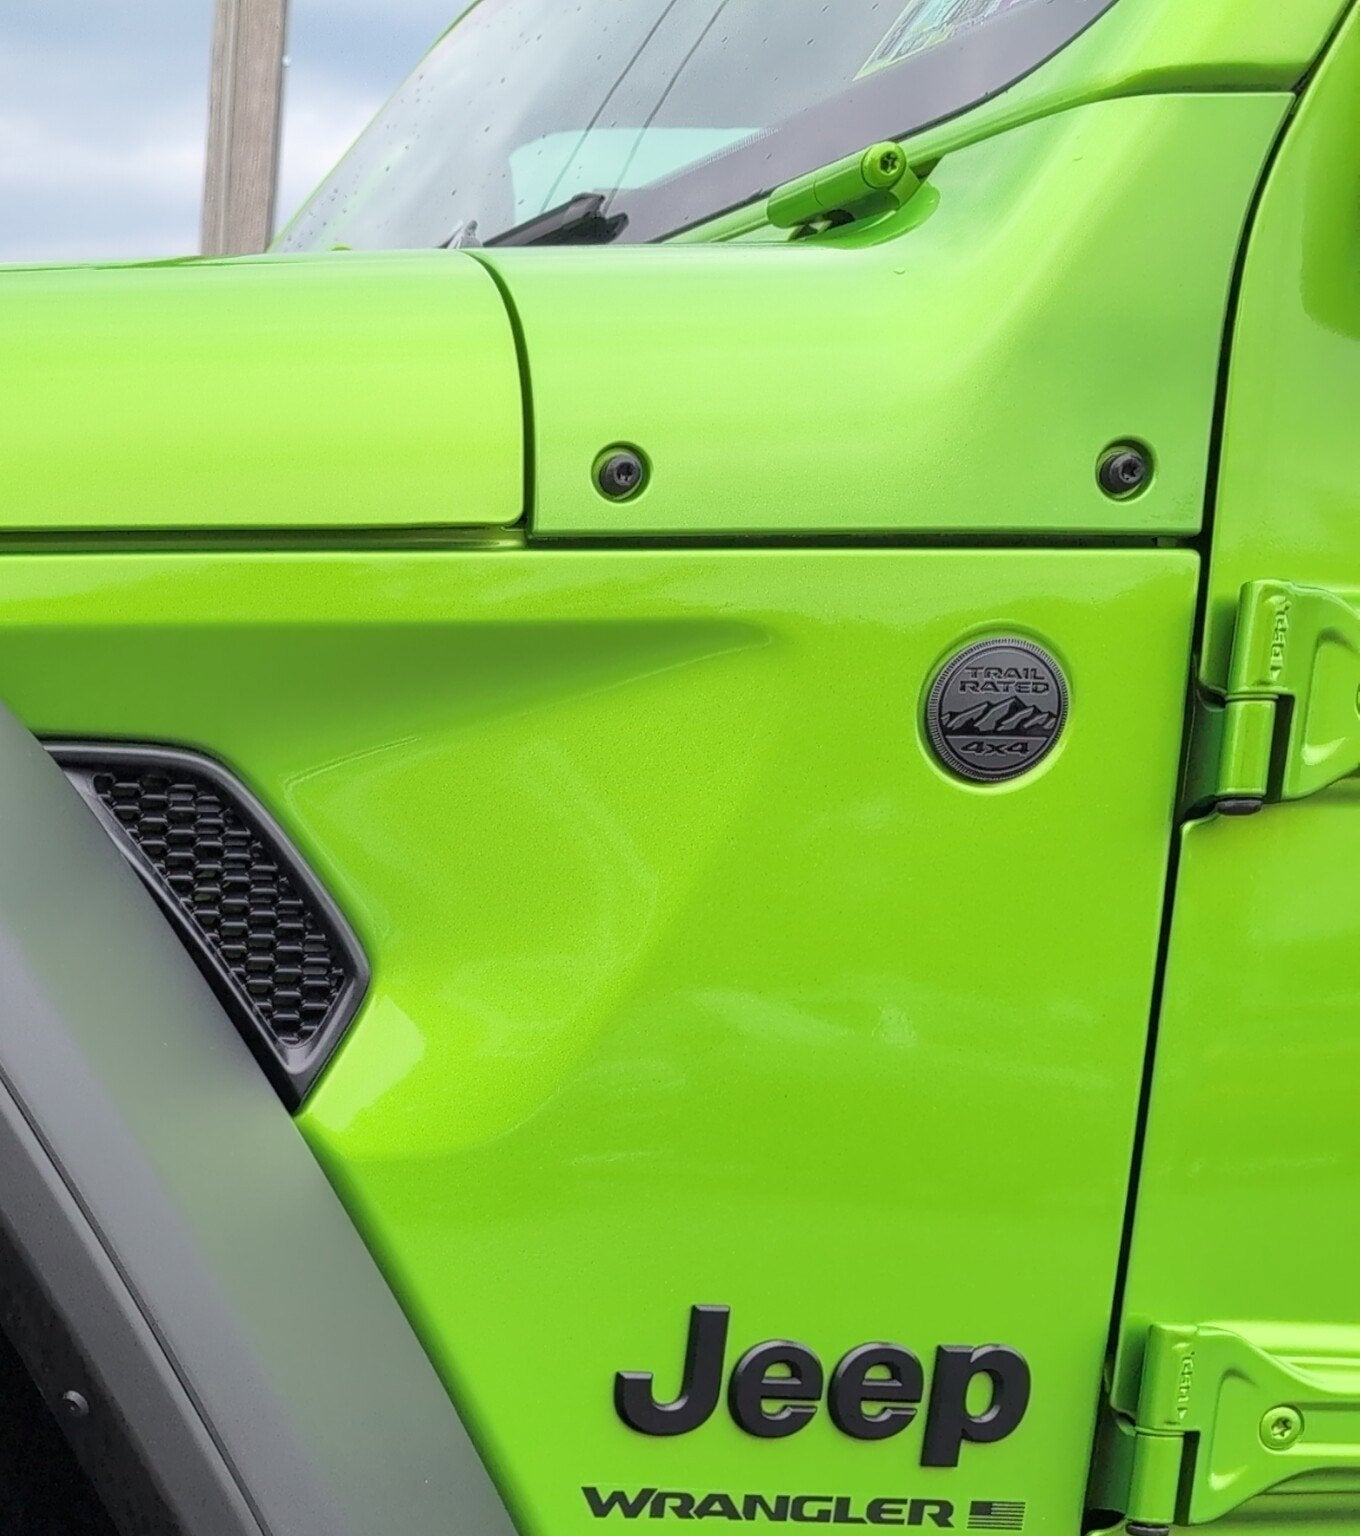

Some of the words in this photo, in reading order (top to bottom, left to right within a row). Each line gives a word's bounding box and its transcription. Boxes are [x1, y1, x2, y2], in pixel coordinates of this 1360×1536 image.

[963, 667, 1045, 679] TRAIL
[959, 680, 1049, 693] RATED
[960, 741, 1028, 755] 4x4
[614, 1304, 1031, 1468] Jeep
[581, 1486, 955, 1530] WRANGLER
